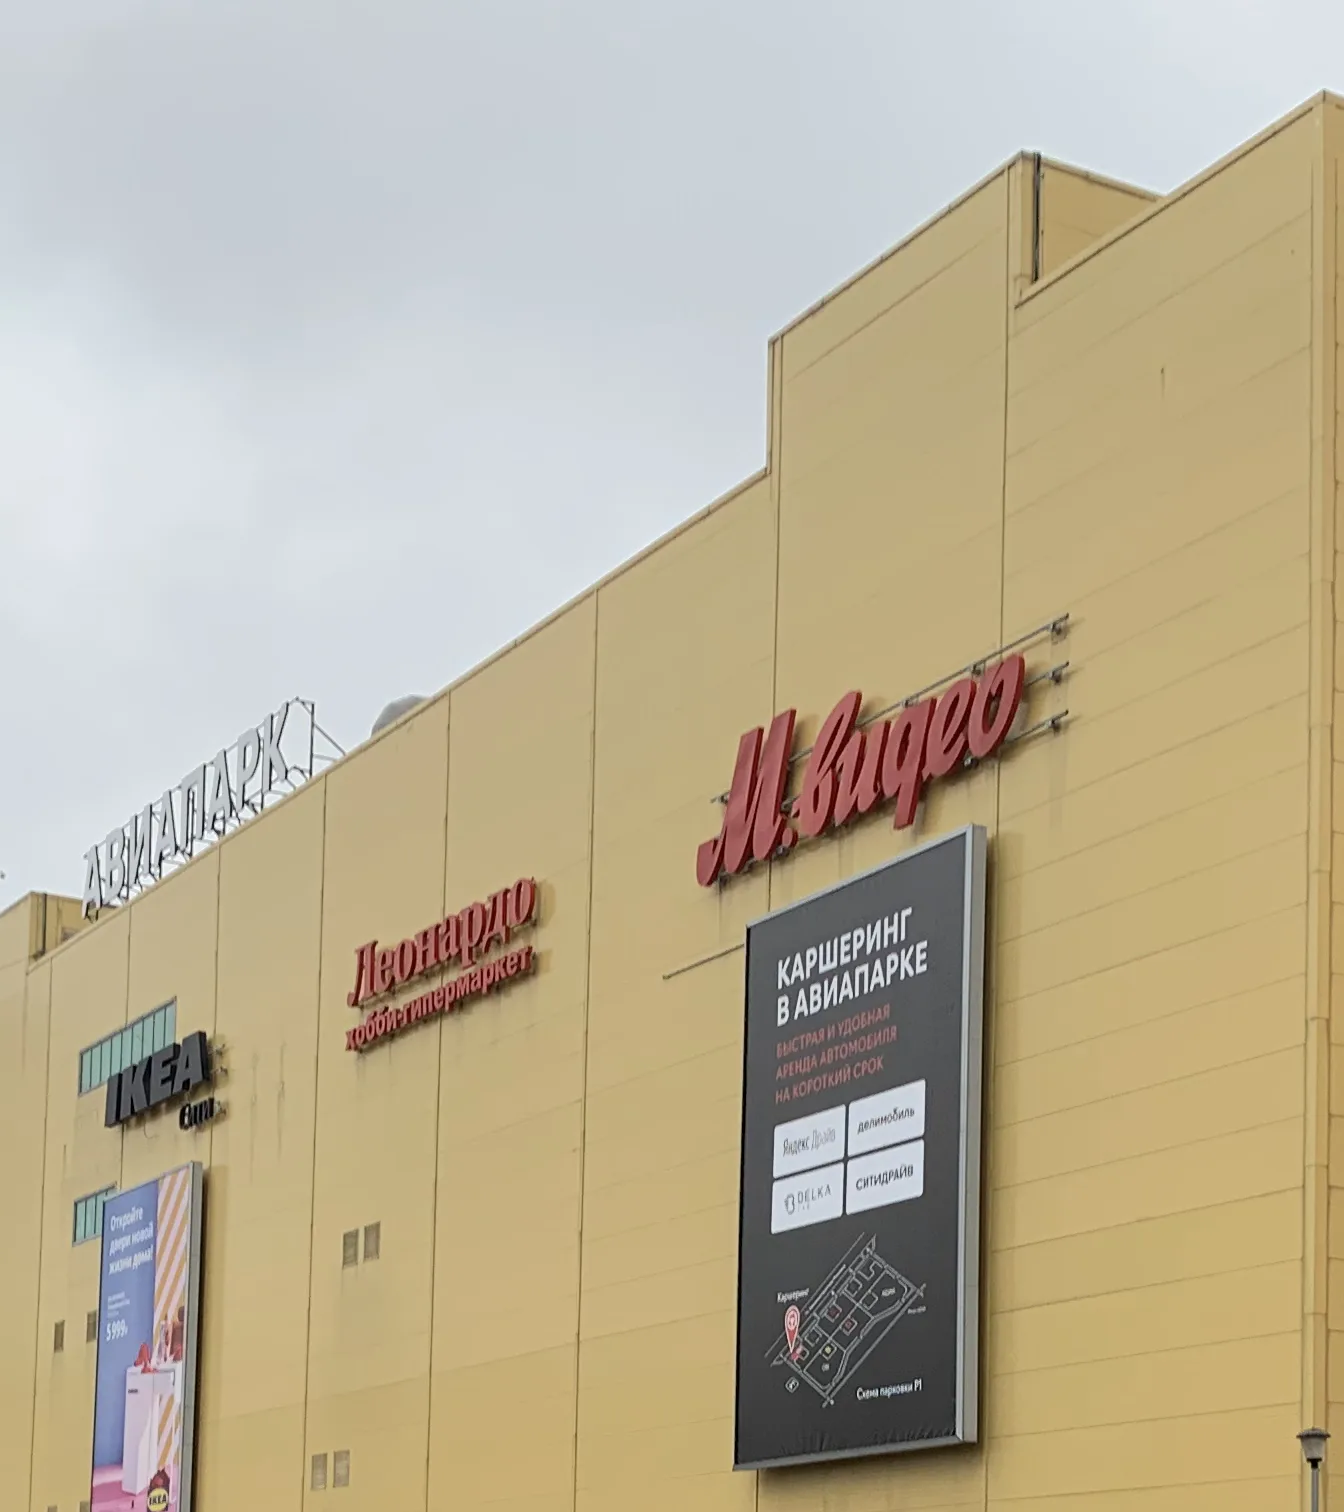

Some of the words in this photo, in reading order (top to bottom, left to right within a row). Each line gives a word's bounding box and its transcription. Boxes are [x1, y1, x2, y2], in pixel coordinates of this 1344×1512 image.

[83, 702, 289, 917] АВИАПАРК
[696, 652, 1025, 887] М.видео
[347, 877, 536, 1008] Леонардо
[777, 906, 913, 990] КАРШЕРИНГ
[777, 995, 790, 1027] В
[793, 940, 928, 1021] АВИАПАРКЕ
[345, 945, 533, 1052] хобби-гипермаркет
[776, 1027, 825, 1059] БЫСТРАЯ
[827, 1025, 835, 1040] И
[838, 1003, 891, 1037] УДОБНАЯ
[105, 1030, 210, 1128] IKEA
[775, 1056, 818, 1081] АРЕНДА
[819, 1025, 898, 1067] АВТОМОБИЛЯ
[775, 1087, 790, 1105] НА
[792, 1064, 851, 1098] КОРОТКИЙ
[853, 1055, 884, 1080] СРОК
[857, 1106, 915, 1135] делимобиль
[855, 1163, 914, 1191] СИТИДРАЙВ
